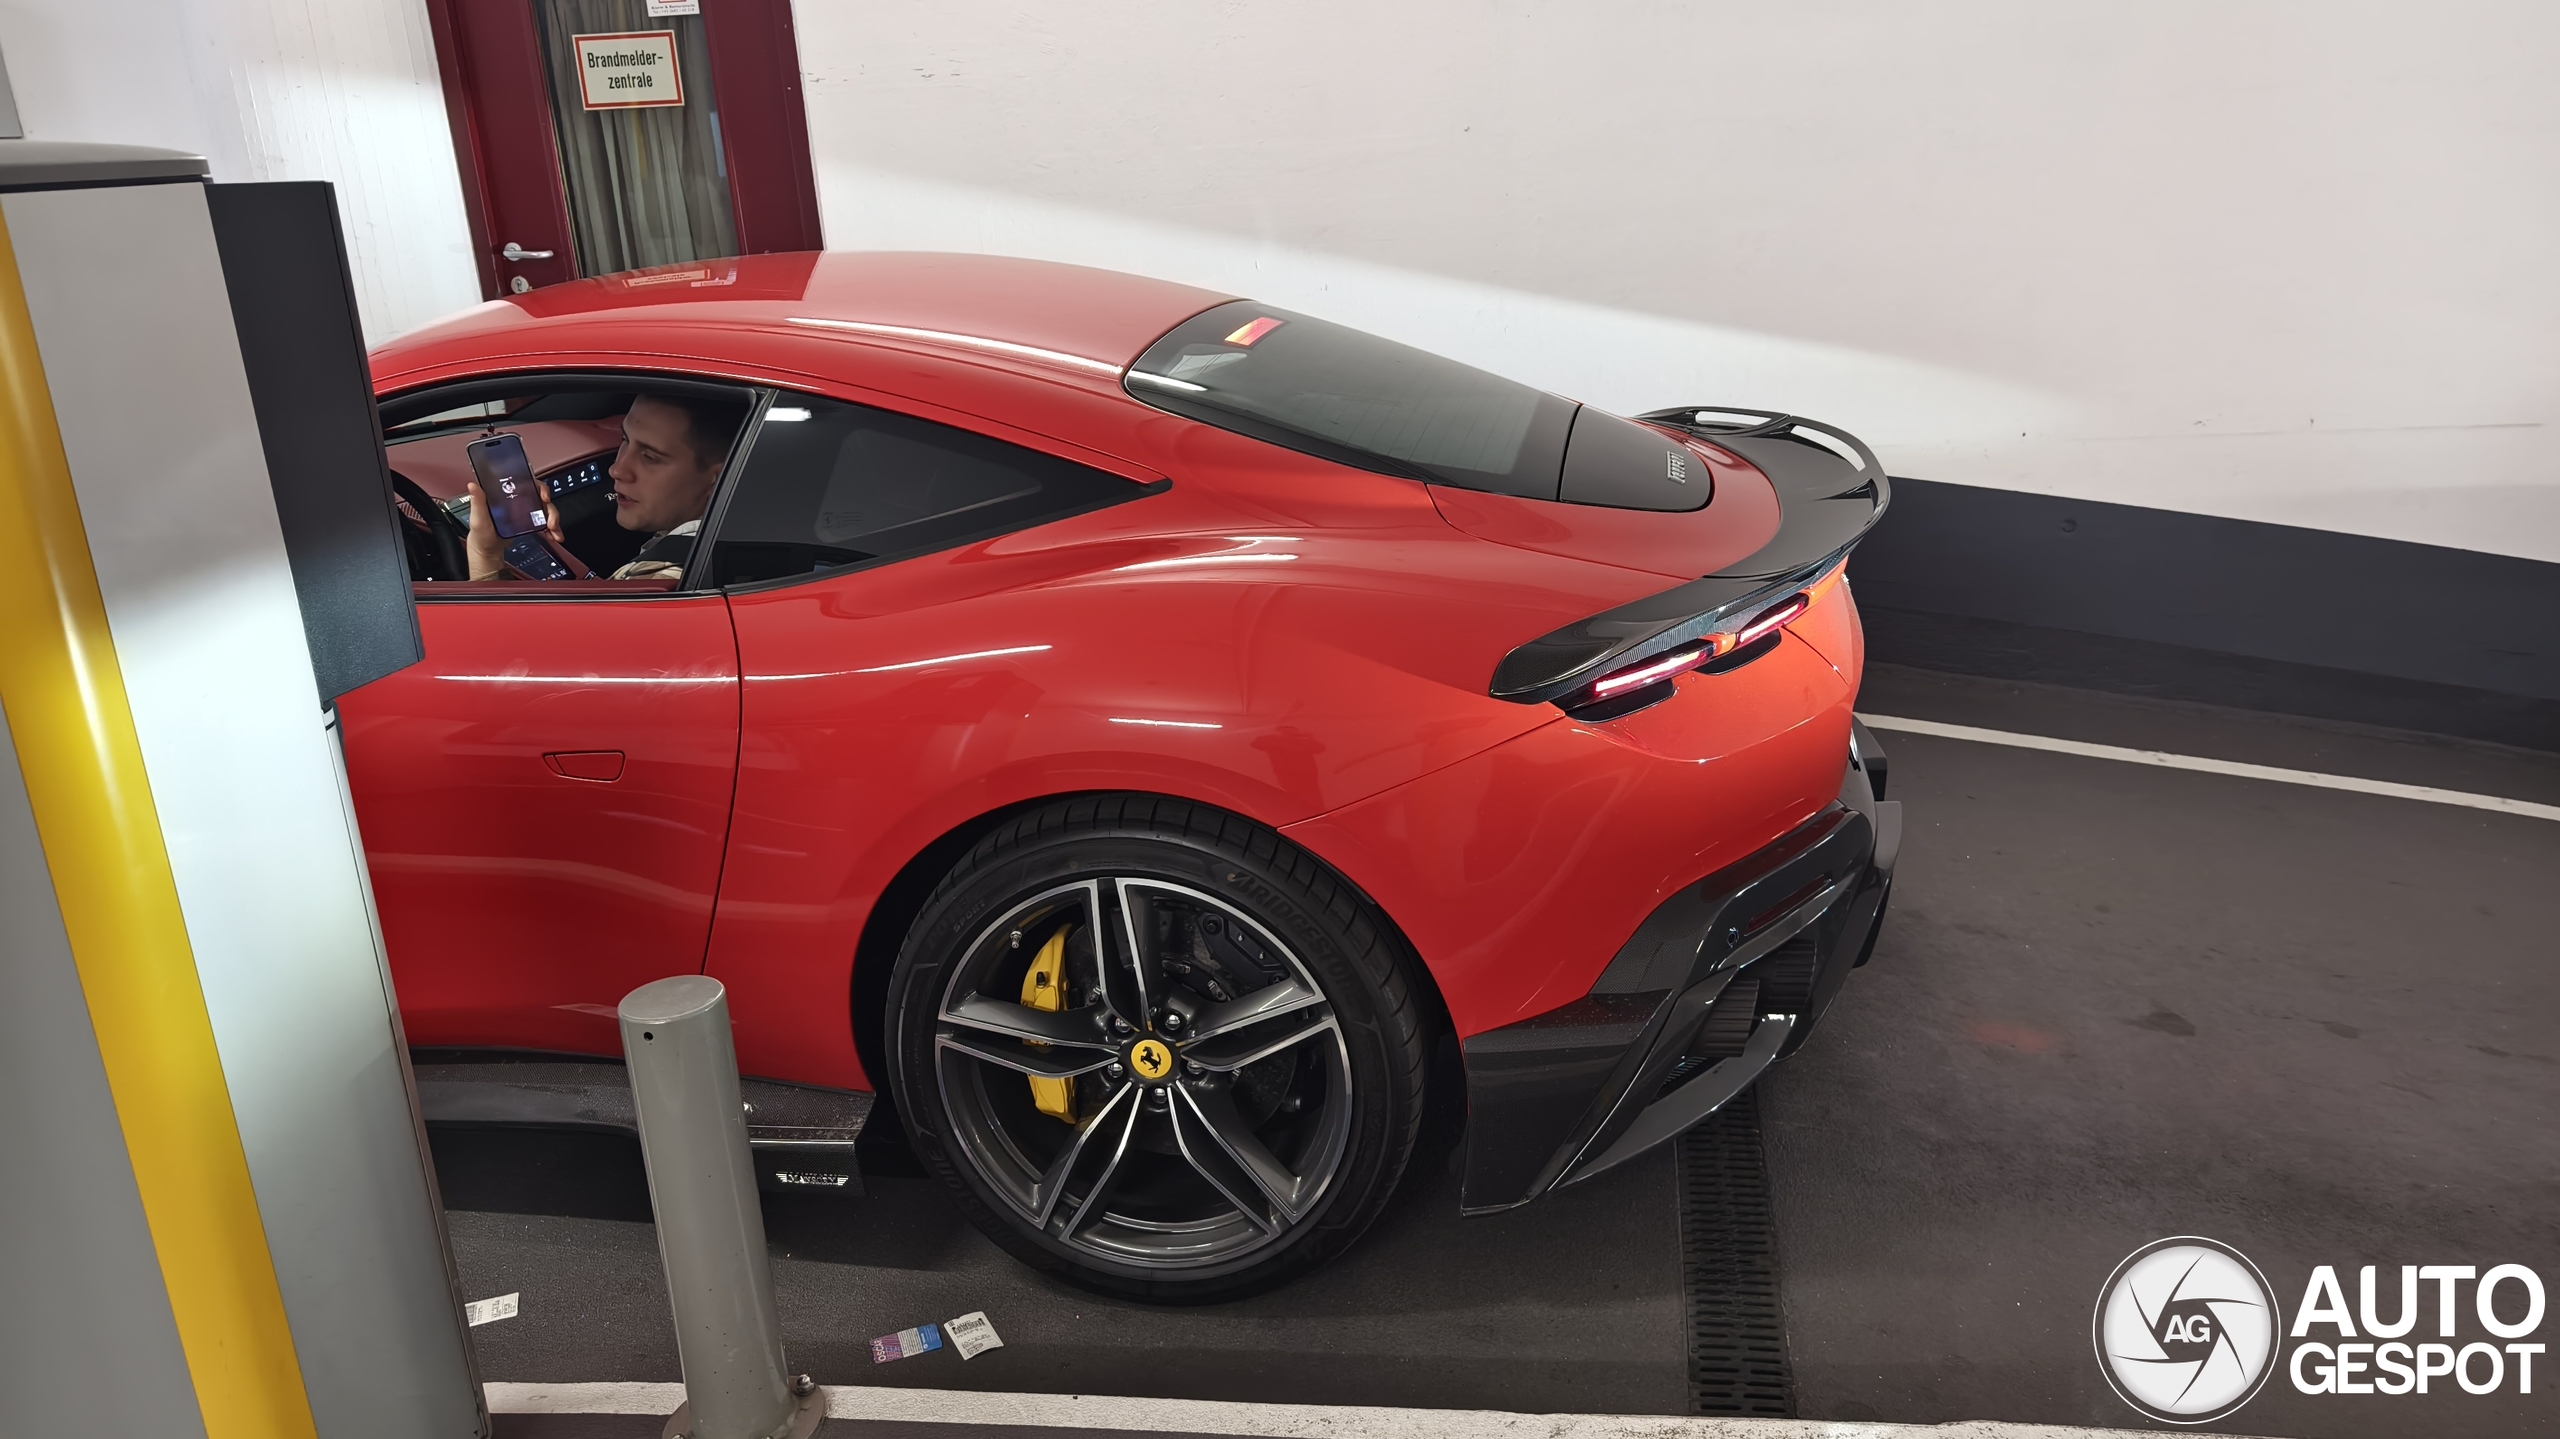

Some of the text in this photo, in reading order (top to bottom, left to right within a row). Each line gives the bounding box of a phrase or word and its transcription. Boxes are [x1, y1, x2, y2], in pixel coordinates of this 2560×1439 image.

[587, 49, 664, 69] Brandmelder-
[607, 72, 653, 90] zentrale
[953, 898, 986, 933] SPORT
